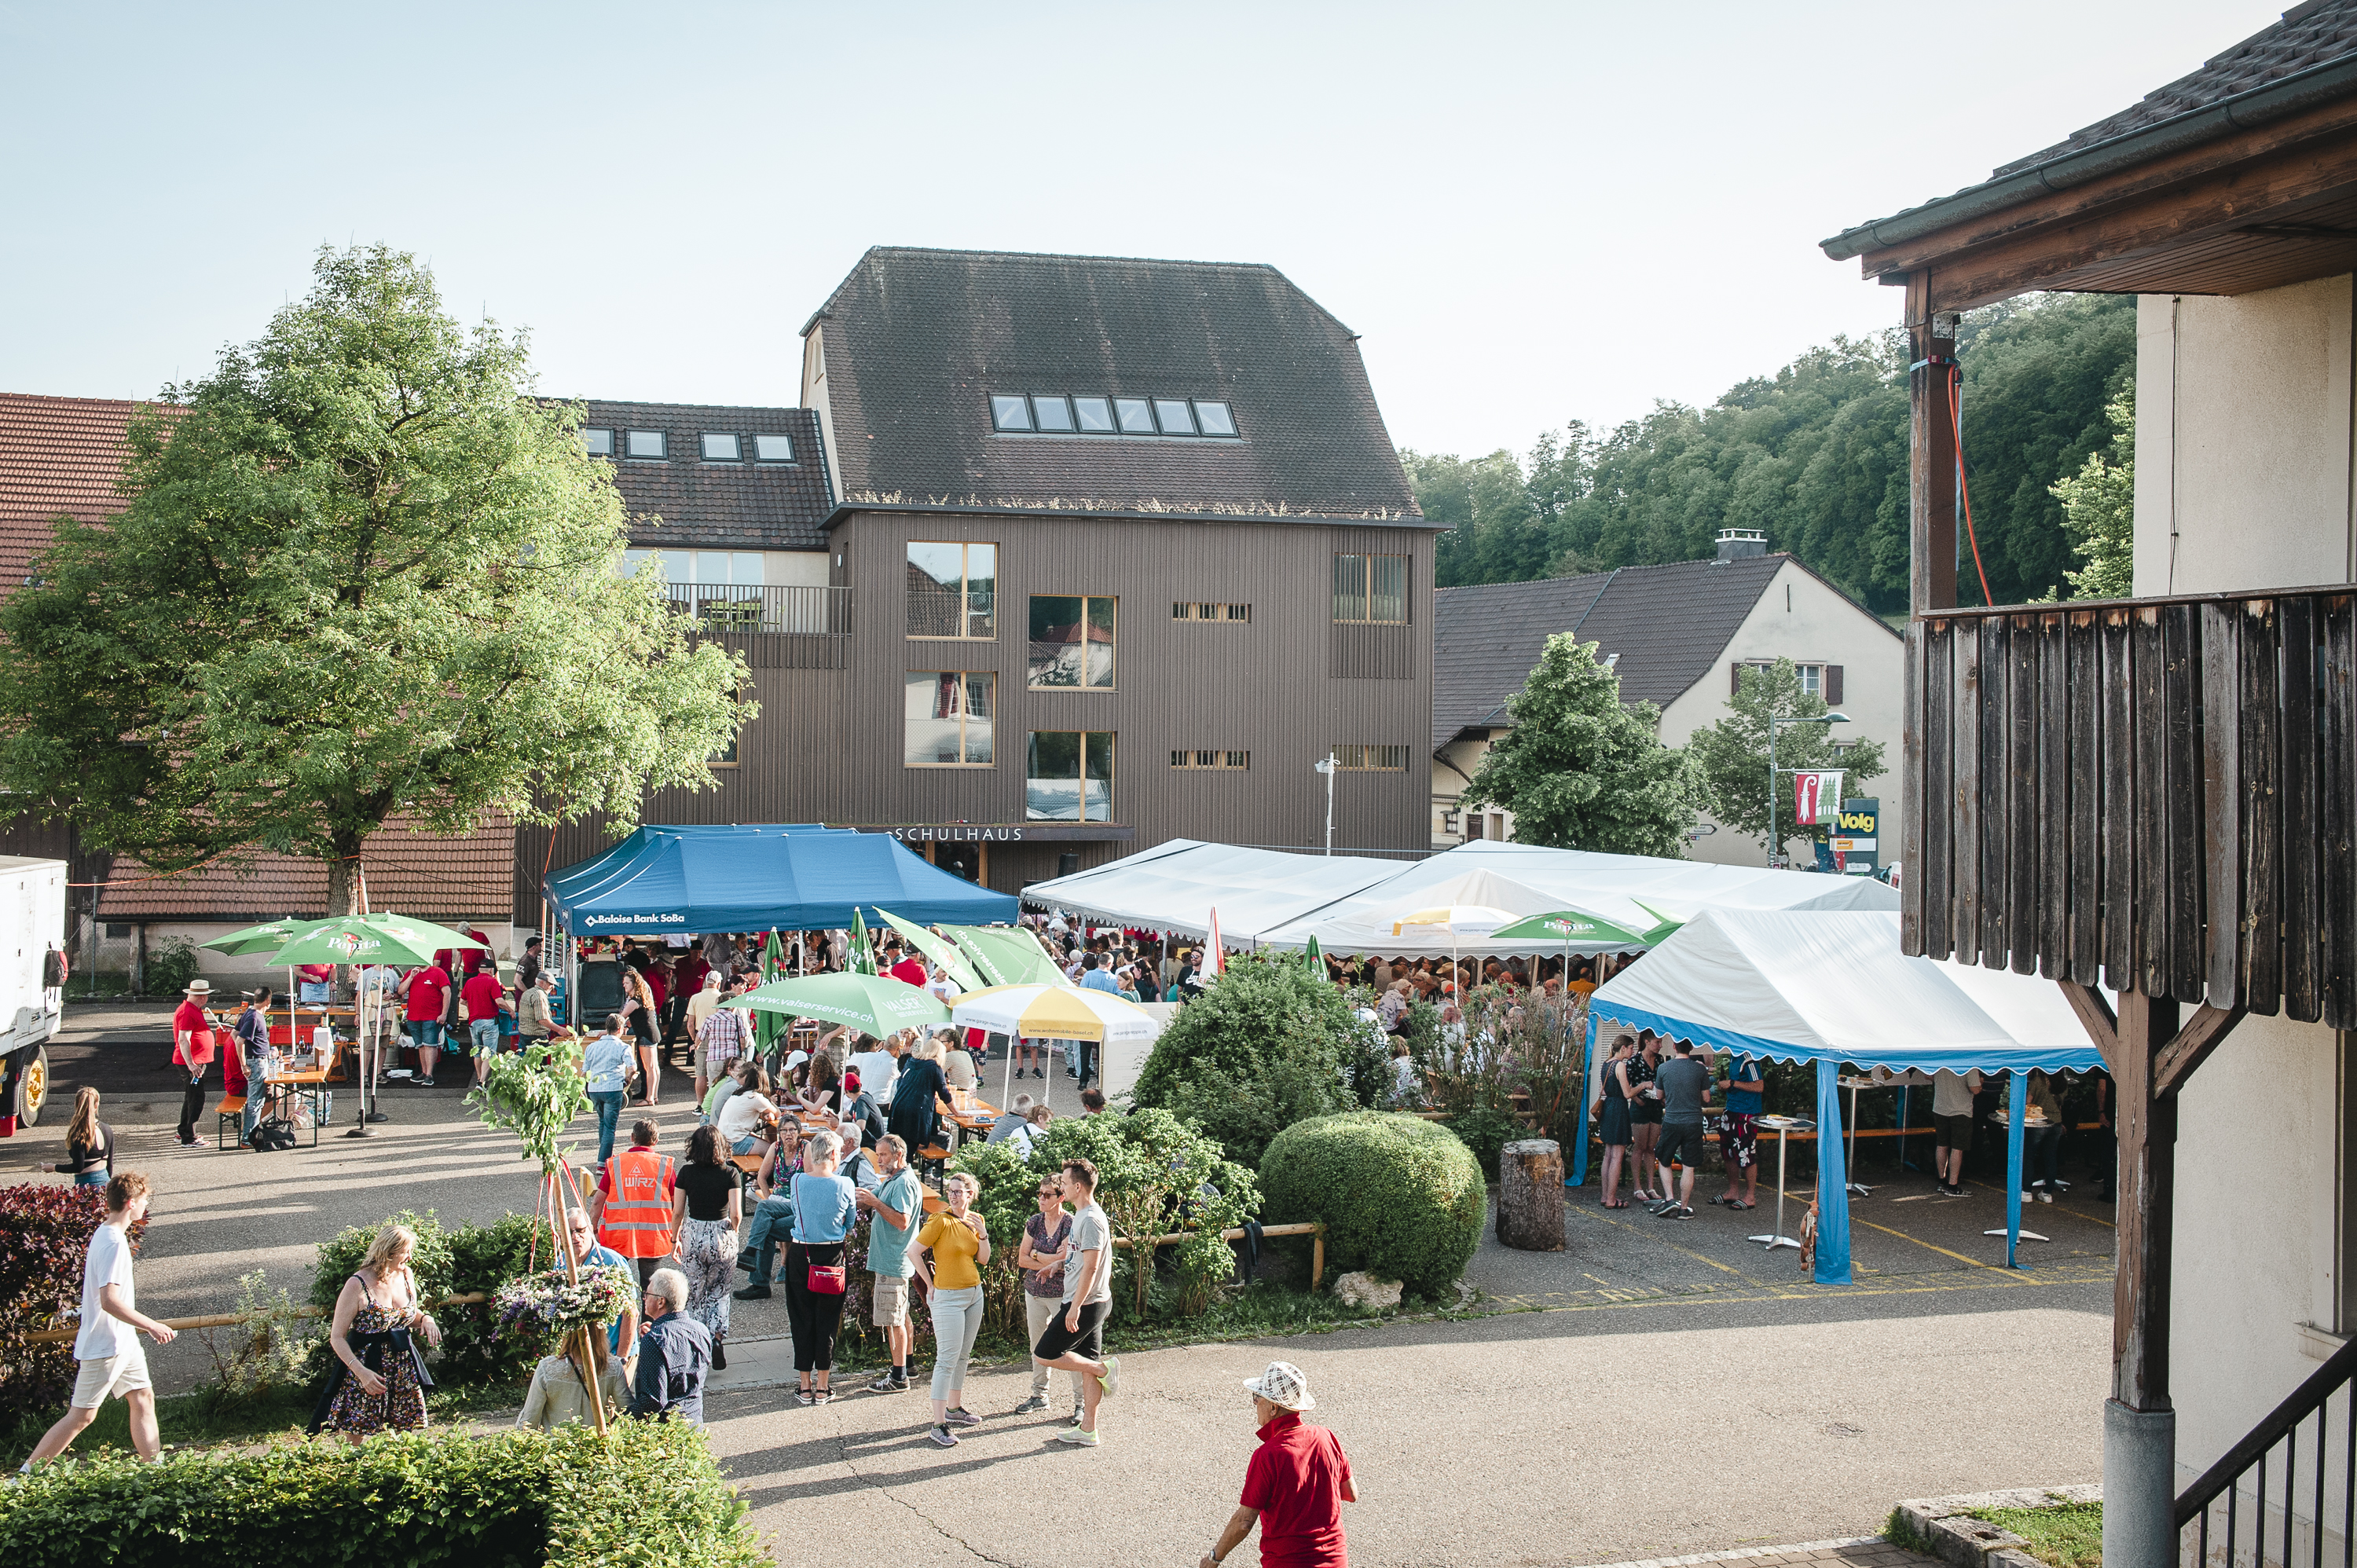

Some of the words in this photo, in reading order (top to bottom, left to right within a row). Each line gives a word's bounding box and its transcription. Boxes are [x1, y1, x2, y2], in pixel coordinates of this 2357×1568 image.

[1838, 812, 1875, 833] Volg
[895, 828, 1022, 841] SCHULHAUS
[598, 914, 632, 924] Baloise
[633, 914, 659, 923] Bank
[660, 914, 685, 922] SoBa
[326, 937, 382, 953] Pepita
[746, 994, 874, 1024] www.valserservice.ch
[882, 998, 925, 1013] VALSER
